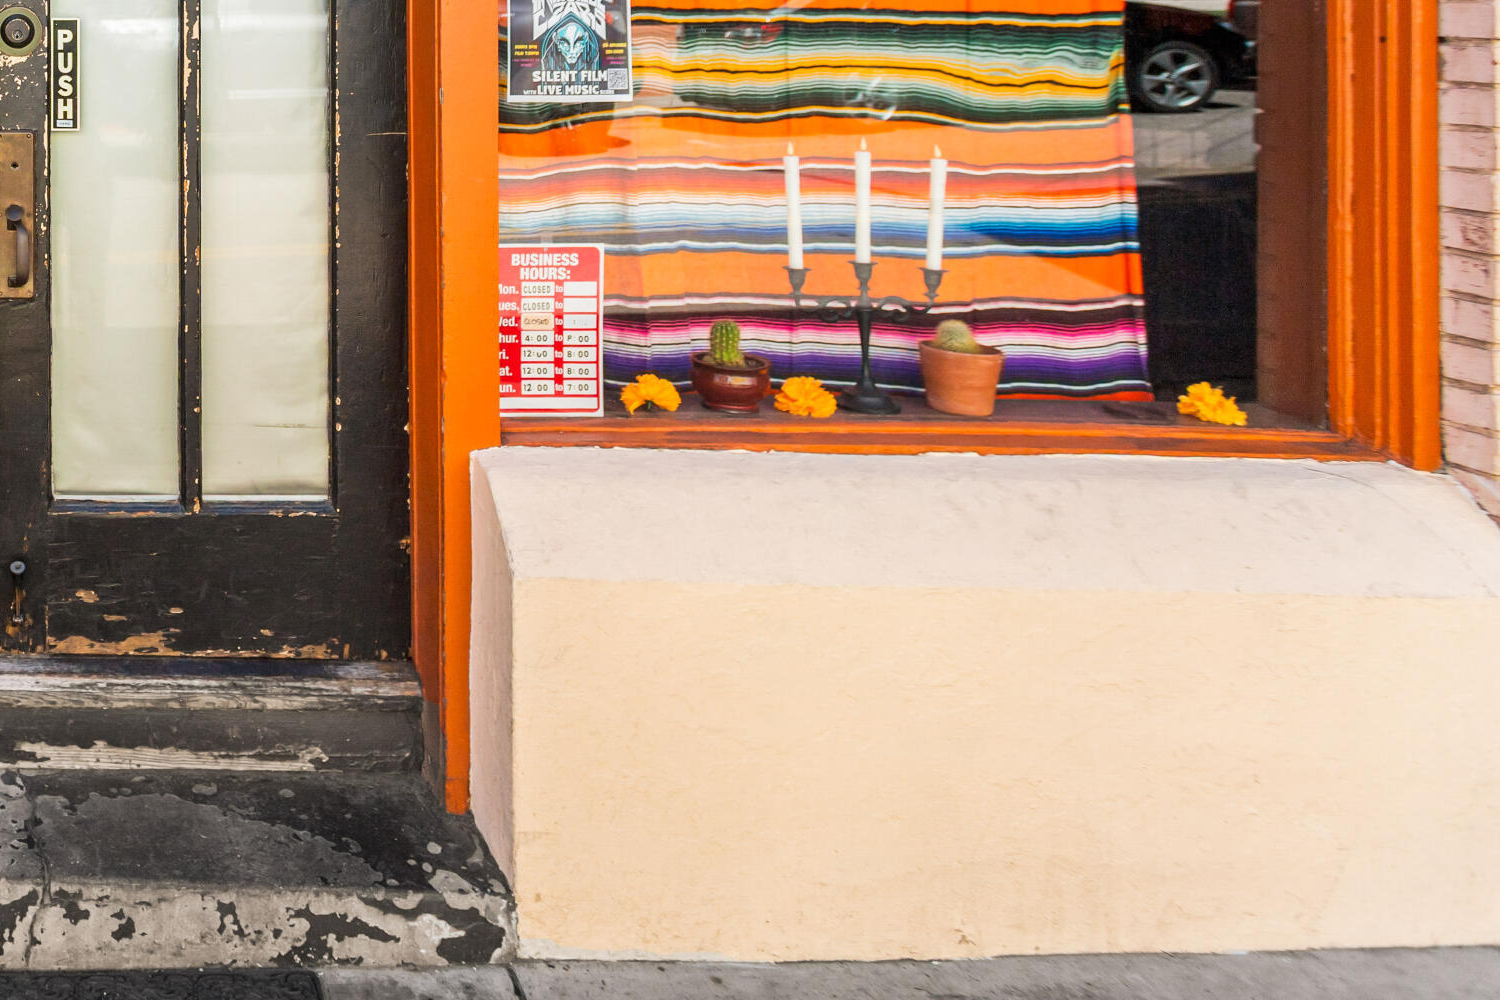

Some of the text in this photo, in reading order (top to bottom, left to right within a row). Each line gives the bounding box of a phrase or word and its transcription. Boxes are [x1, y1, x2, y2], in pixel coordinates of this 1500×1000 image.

[57, 28, 74, 120] PUSH
[532, 70, 608, 82] SILENT FILM
[537, 85, 563, 95] LIVE
[565, 84, 600, 95] MUSIC
[511, 253, 579, 267] BUSINESS
[520, 267, 571, 281] HOURS:
[523, 285, 551, 294] CLOSED
[555, 284, 564, 292] to
[498, 301, 564, 311] ues. CLOSED to
[555, 318, 564, 326] to
[498, 333, 519, 343] hur.
[524, 334, 548, 342] 4:00
[555, 334, 564, 342] to
[498, 349, 509, 359] ri.
[555, 350, 564, 358] to
[567, 350, 589, 358] 8:00
[499, 366, 513, 376] at.
[522, 367, 548, 375] 12:00
[555, 367, 564, 375] to
[499, 383, 516, 393] un.
[555, 384, 564, 392] to
[567, 384, 589, 392] 7:00
